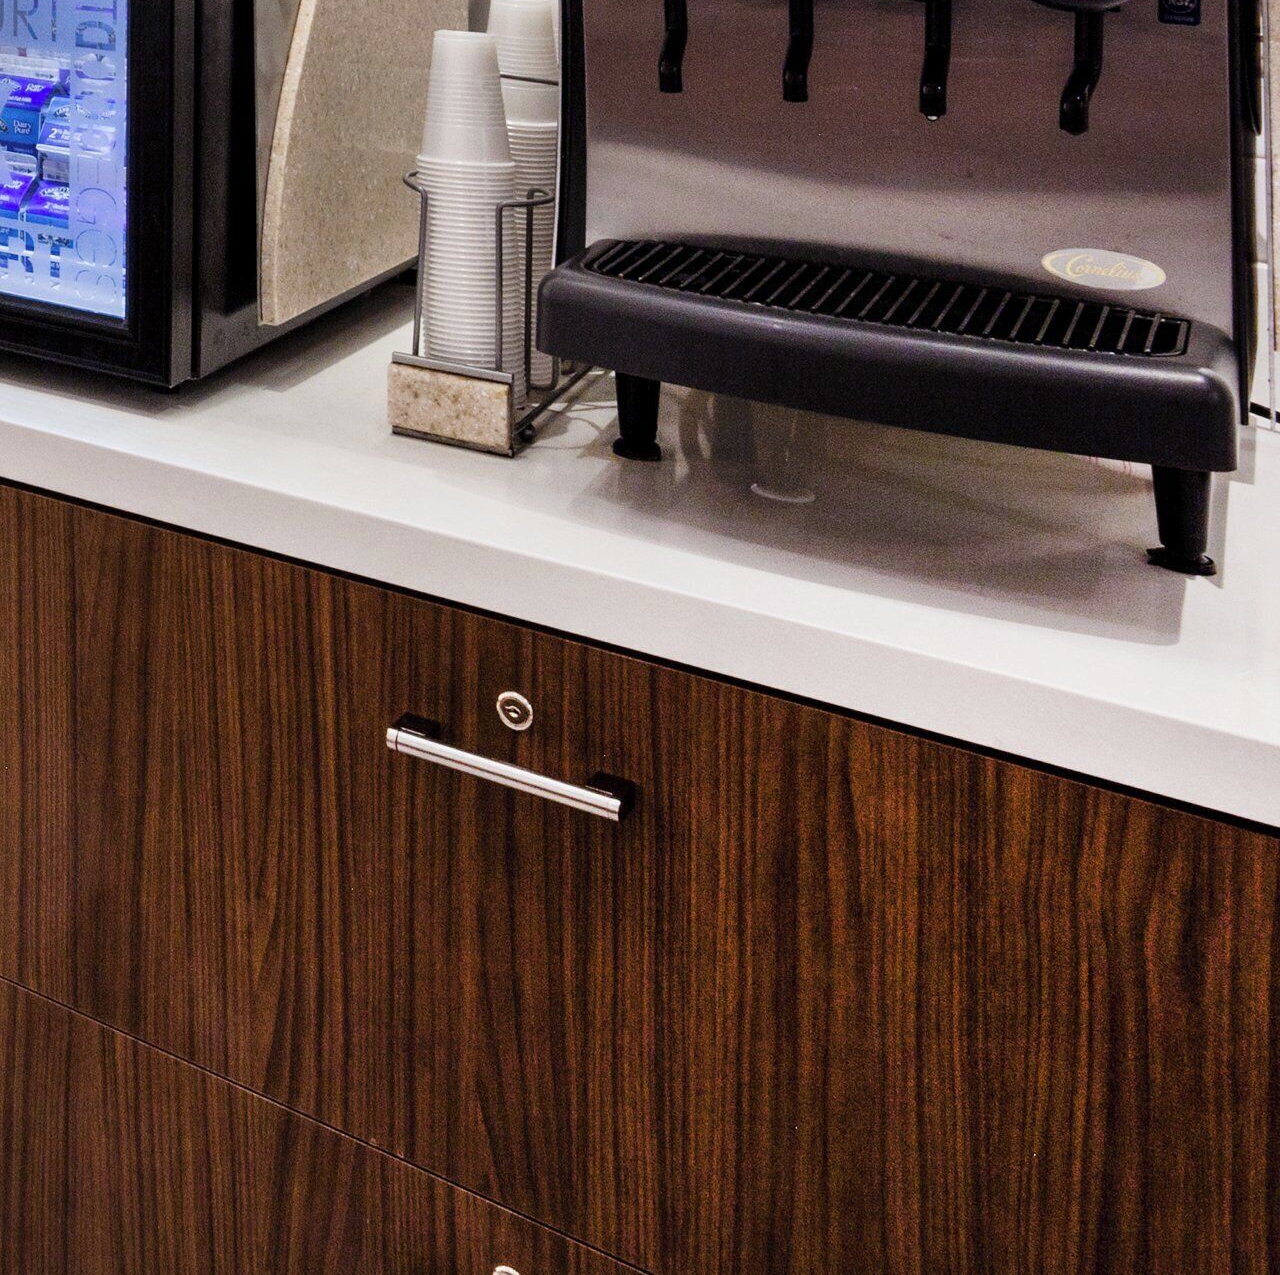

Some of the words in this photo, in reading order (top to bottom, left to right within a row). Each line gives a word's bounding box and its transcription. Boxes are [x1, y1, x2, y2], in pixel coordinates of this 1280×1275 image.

[13, 119, 32, 130] Dairy
[14, 125, 31, 135] Pure
[1066, 254, 1141, 282] Cornelius
